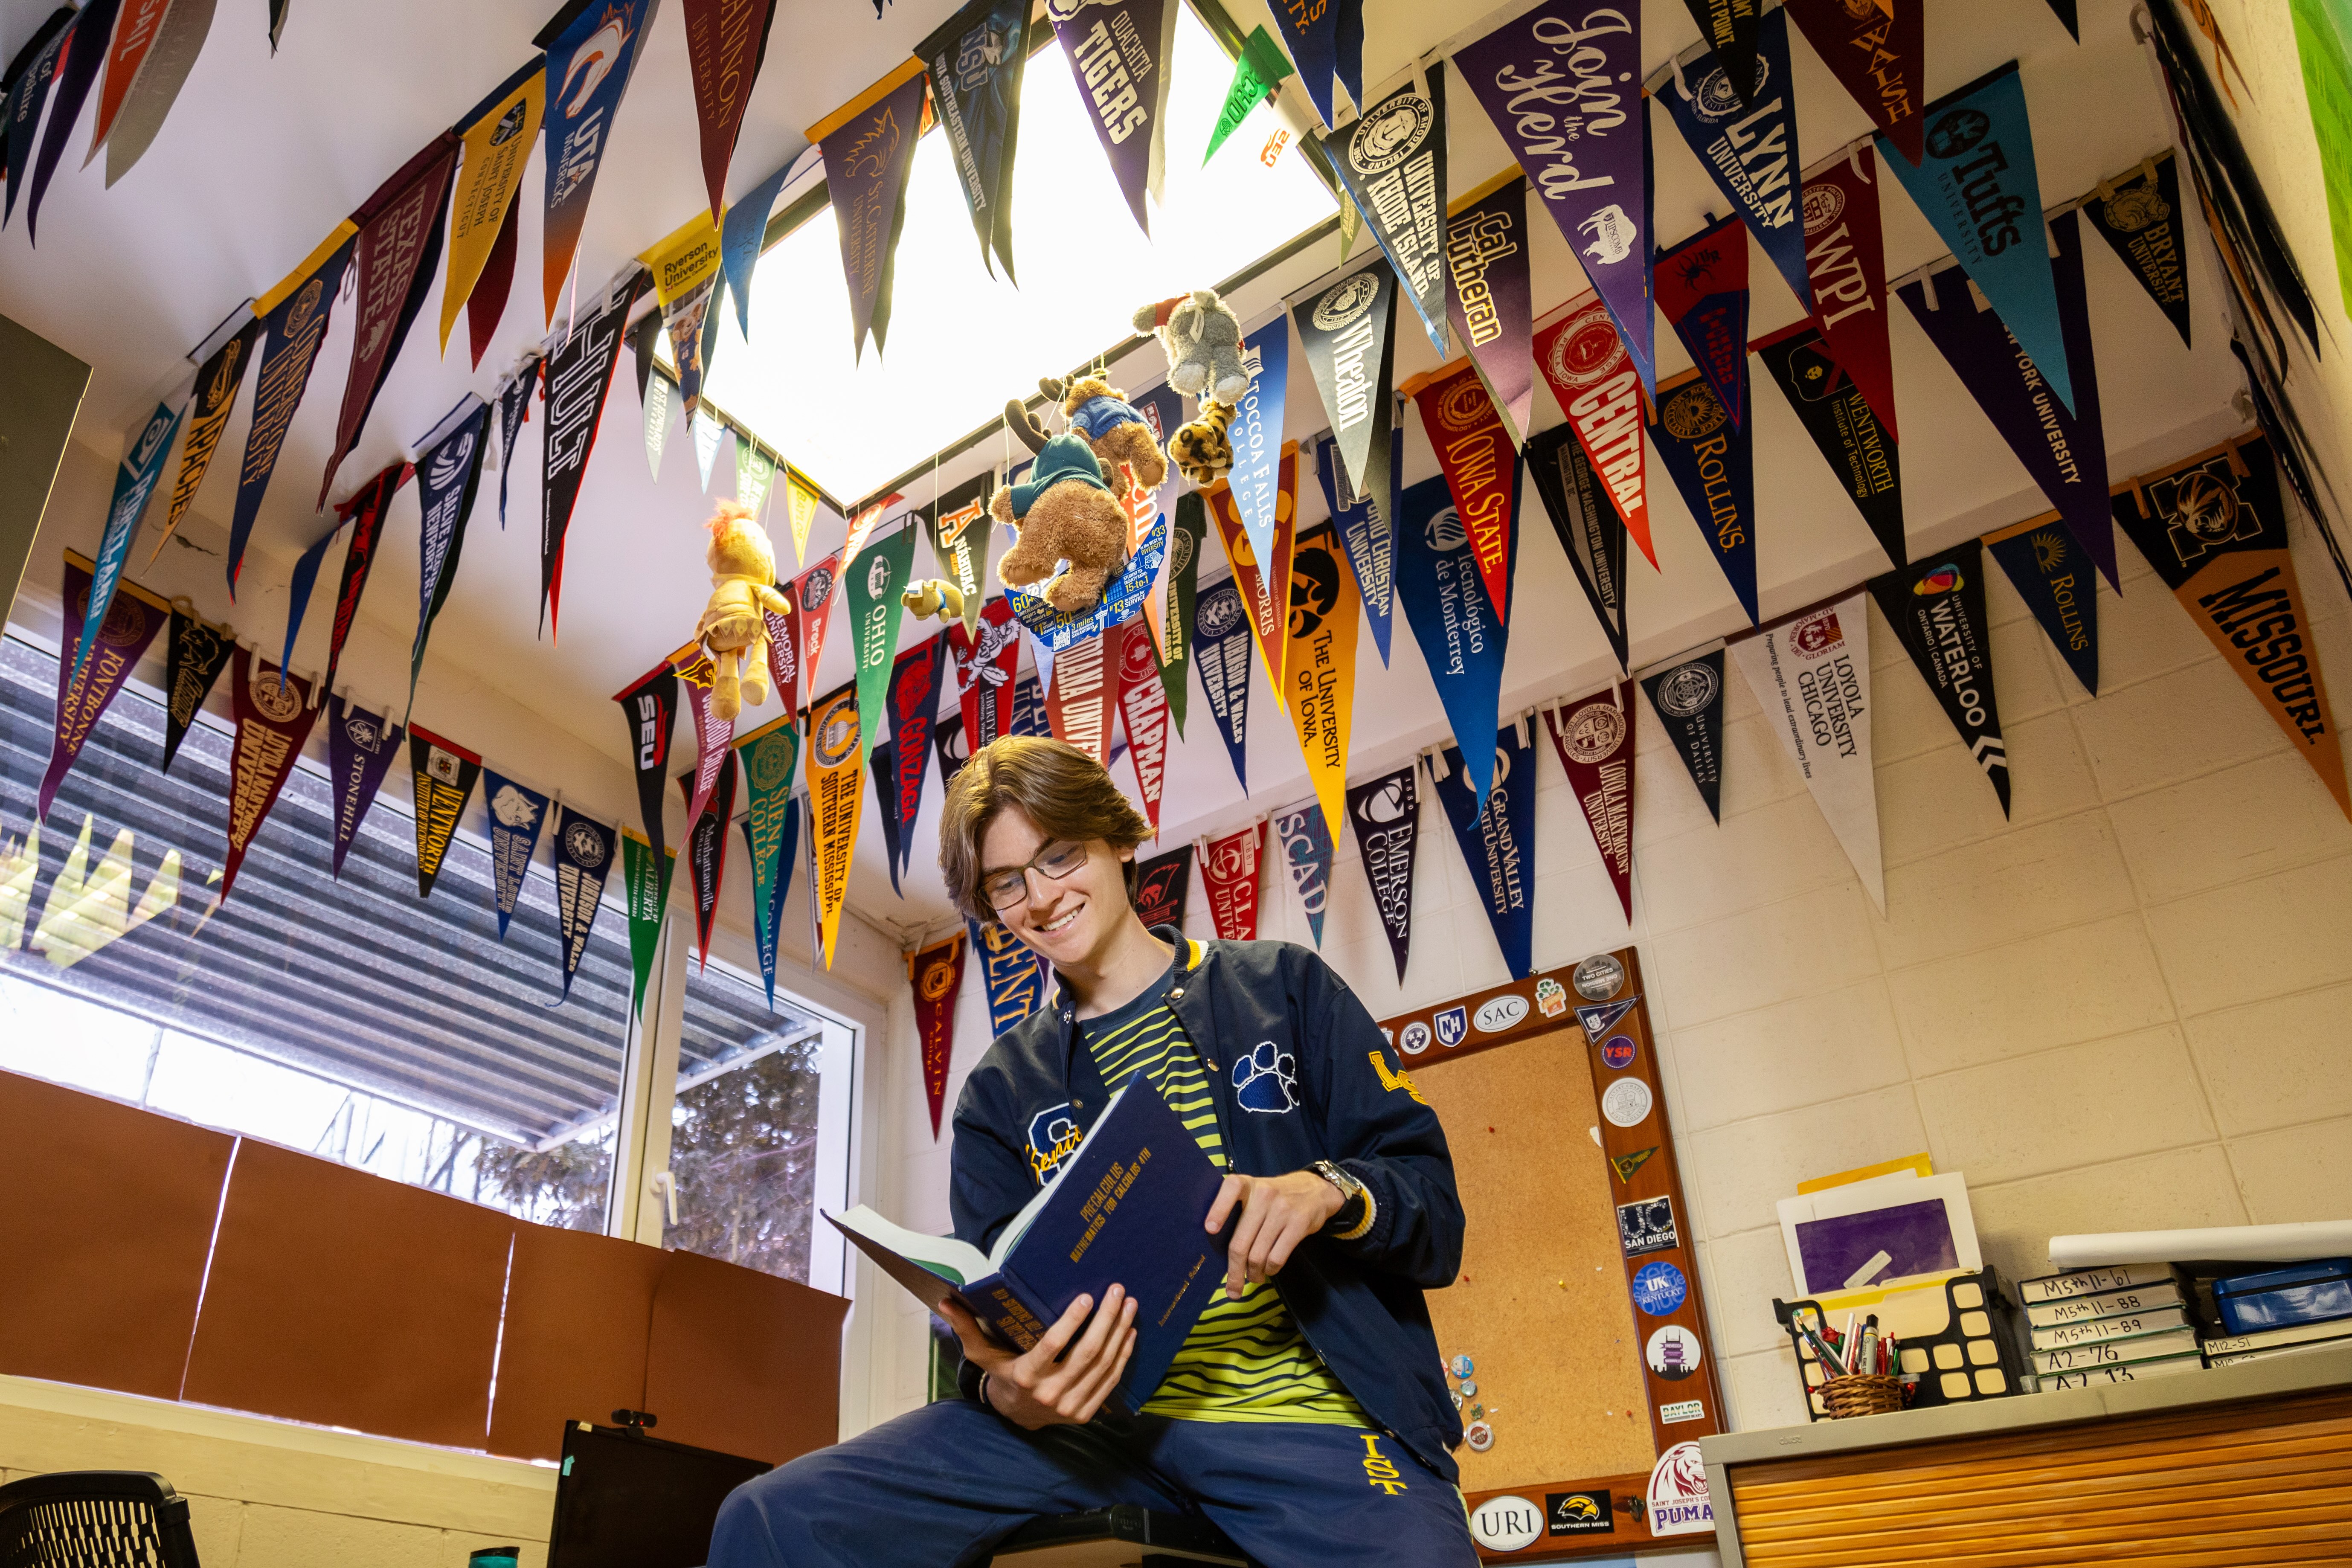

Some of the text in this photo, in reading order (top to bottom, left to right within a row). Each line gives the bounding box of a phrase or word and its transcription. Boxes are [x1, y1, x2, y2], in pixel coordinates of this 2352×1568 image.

[692, 14, 716, 121] UNIVERSITY
[956, 23, 989, 91] NSU
[1074, 19, 1148, 145] TIGERS
[1110, 10, 1154, 83] OUACHITA
[1533, 8, 1632, 136] Join
[1849, 21, 1914, 125] WALSH
[563, 107, 604, 201] UTA
[939, 73, 987, 213] SOUTHEASTERN UNIVERSITY
[1496, 59, 1615, 200] Herd
[1563, 116, 1585, 141] the
[1725, 97, 1794, 229] LYNN
[457, 157, 491, 238] CONNECTICUT
[474, 145, 508, 226] SAINT JOSEPH
[488, 135, 523, 223] UNIVERSITY OF
[551, 131, 575, 209] MAVERICKS
[1707, 136, 1774, 228] UNIVERSITY
[1951, 141, 2026, 256] Tufts
[385, 187, 427, 307] TEXAS
[849, 194, 865, 277] UNIVERSITY
[862, 210, 883, 300] CATHERINE
[1367, 168, 1429, 299] RHODE ISLAND.
[1404, 150, 1440, 281] UNIVERSITY OF
[1472, 211, 1518, 260] Cal
[1604, 212, 1623, 254] LIPSCOMB
[1937, 172, 1983, 266] UNIVERSITY
[362, 207, 397, 328] STATE
[664, 241, 708, 276] Ryerson
[665, 246, 718, 287] University
[1448, 218, 1502, 347] Lutheran
[1809, 223, 1875, 331] WPI
[2127, 235, 2171, 306] UNIVERSITY
[2143, 221, 2185, 302] BRYANT
[256, 314, 325, 479] CORNERSTONE
[548, 287, 630, 481] HULT
[1333, 314, 1373, 432] Wheaton
[243, 341, 296, 487] UNIVERSITY
[1244, 378, 1272, 527] TOCCOA FALLS
[1569, 370, 1643, 519] CENTRAL
[1832, 399, 1869, 498] Institute Technology
[1848, 392, 1894, 494] WENTWORTH
[2013, 350, 2082, 485] YORK UNIVERSITY
[168, 409, 226, 526] APACHES
[1446, 423, 1505, 574] IOWA STATE.
[1693, 433, 1745, 554] ROLLINS
[439, 485, 461, 540] SALVE
[796, 490, 807, 540] BAYLOR
[1141, 541, 1164, 555] DIVERSITY
[1152, 525, 1166, 537] #33
[1124, 593, 1146, 607] SERVICE
[1126, 575, 1149, 593] 15-to-1
[1347, 521, 1378, 607] UNIVERSITY
[1592, 550, 1616, 607] UNIVERSITY
[765, 612, 790, 683] UNIVERSITY
[810, 618, 821, 655] Brock
[862, 612, 871, 672] UNIVERSITY
[871, 605, 886, 666] OHIO
[1032, 613, 1046, 623] minors
[1075, 616, 1094, 629] miles
[1109, 600, 1124, 614] #13
[1436, 560, 1465, 676] de Monterrey
[1918, 609, 1934, 647] ONTARIO
[1952, 594, 1977, 653] UNIVERSITY
[2050, 572, 2088, 651] ROLLINS
[1198, 644, 1227, 718] UNIVERSITY
[1224, 632, 1248, 744] JOHNSON WALES
[1298, 671, 1312, 693] OF
[1834, 654, 1865, 720] LOYOLA
[1931, 599, 1986, 727] WATERLOO
[2198, 566, 2325, 738] MISSOURI
[67, 647, 125, 757] FONTBONNE
[638, 696, 654, 770] SEU
[986, 689, 996, 726] LIBERTY
[1313, 630, 1341, 769] THE UNIVERSITY
[1765, 633, 1812, 779] Preparing people lead extraordinary lives
[1798, 671, 1831, 747] CHICAGO
[1816, 661, 1857, 759] UNIVERSITY
[229, 717, 262, 845] UNIVERSITY
[699, 749, 723, 795] COLLEGE
[899, 715, 928, 823] GONZAGA
[1123, 681, 1165, 803] CHAPMAN
[1687, 724, 1706, 784] OF DALLAS
[1695, 714, 1717, 783] UNIVERSITY
[339, 753, 365, 842] STONEHILL
[766, 786, 789, 858] SIENA
[821, 772, 839, 840] SOUTHERN
[841, 769, 858, 805] THE
[1404, 777, 1414, 810] 1880
[1583, 790, 1614, 859] UNIVERSITY
[424, 782, 465, 876] WENTWORTH
[702, 823, 715, 912] Manhattanville
[751, 799, 767, 888] COLLEGE
[1244, 841, 1253, 867] 1887
[1277, 813, 1326, 915] SCAD
[1491, 788, 1524, 909] GRAND VALLEY
[504, 834, 531, 914] SAINT LOUIS
[558, 863, 581, 939] UNIVERSITY
[643, 863, 654, 921] ALBERTA
[1365, 833, 1394, 925] COLLEGE
[1388, 822, 1412, 939] EMERSON
[1484, 832, 1507, 915] UNIVERSITY
[568, 872, 602, 973] JOHNSON WALES
[1484, 1002, 1519, 1025] SAC
[1582, 968, 1613, 981] TWO CITIES
[1582, 978, 1605, 988] MISSION
[933, 1002, 943, 1096] CALVIN
[1442, 1016, 1461, 1035] NH
[1605, 1047, 1632, 1058] YSR
[1069, 1147, 1151, 1263] MATHEMATICS FOR CALCULUS 4TH
[1080, 1161, 1124, 1222] PRECALCULUS
[1625, 1231, 1675, 1249] SAN DIEGO
[1642, 1287, 1681, 1304] KENTUCKY
[1646, 1276, 1670, 1292] UK
[2049, 1344, 2118, 1371] A2-76
[2208, 1338, 2251, 1353] M12-51
[1663, 1402, 1701, 1417] BAYLOR
[1360, 1434, 1408, 1495] IST
[1481, 1510, 1535, 1536] URI
